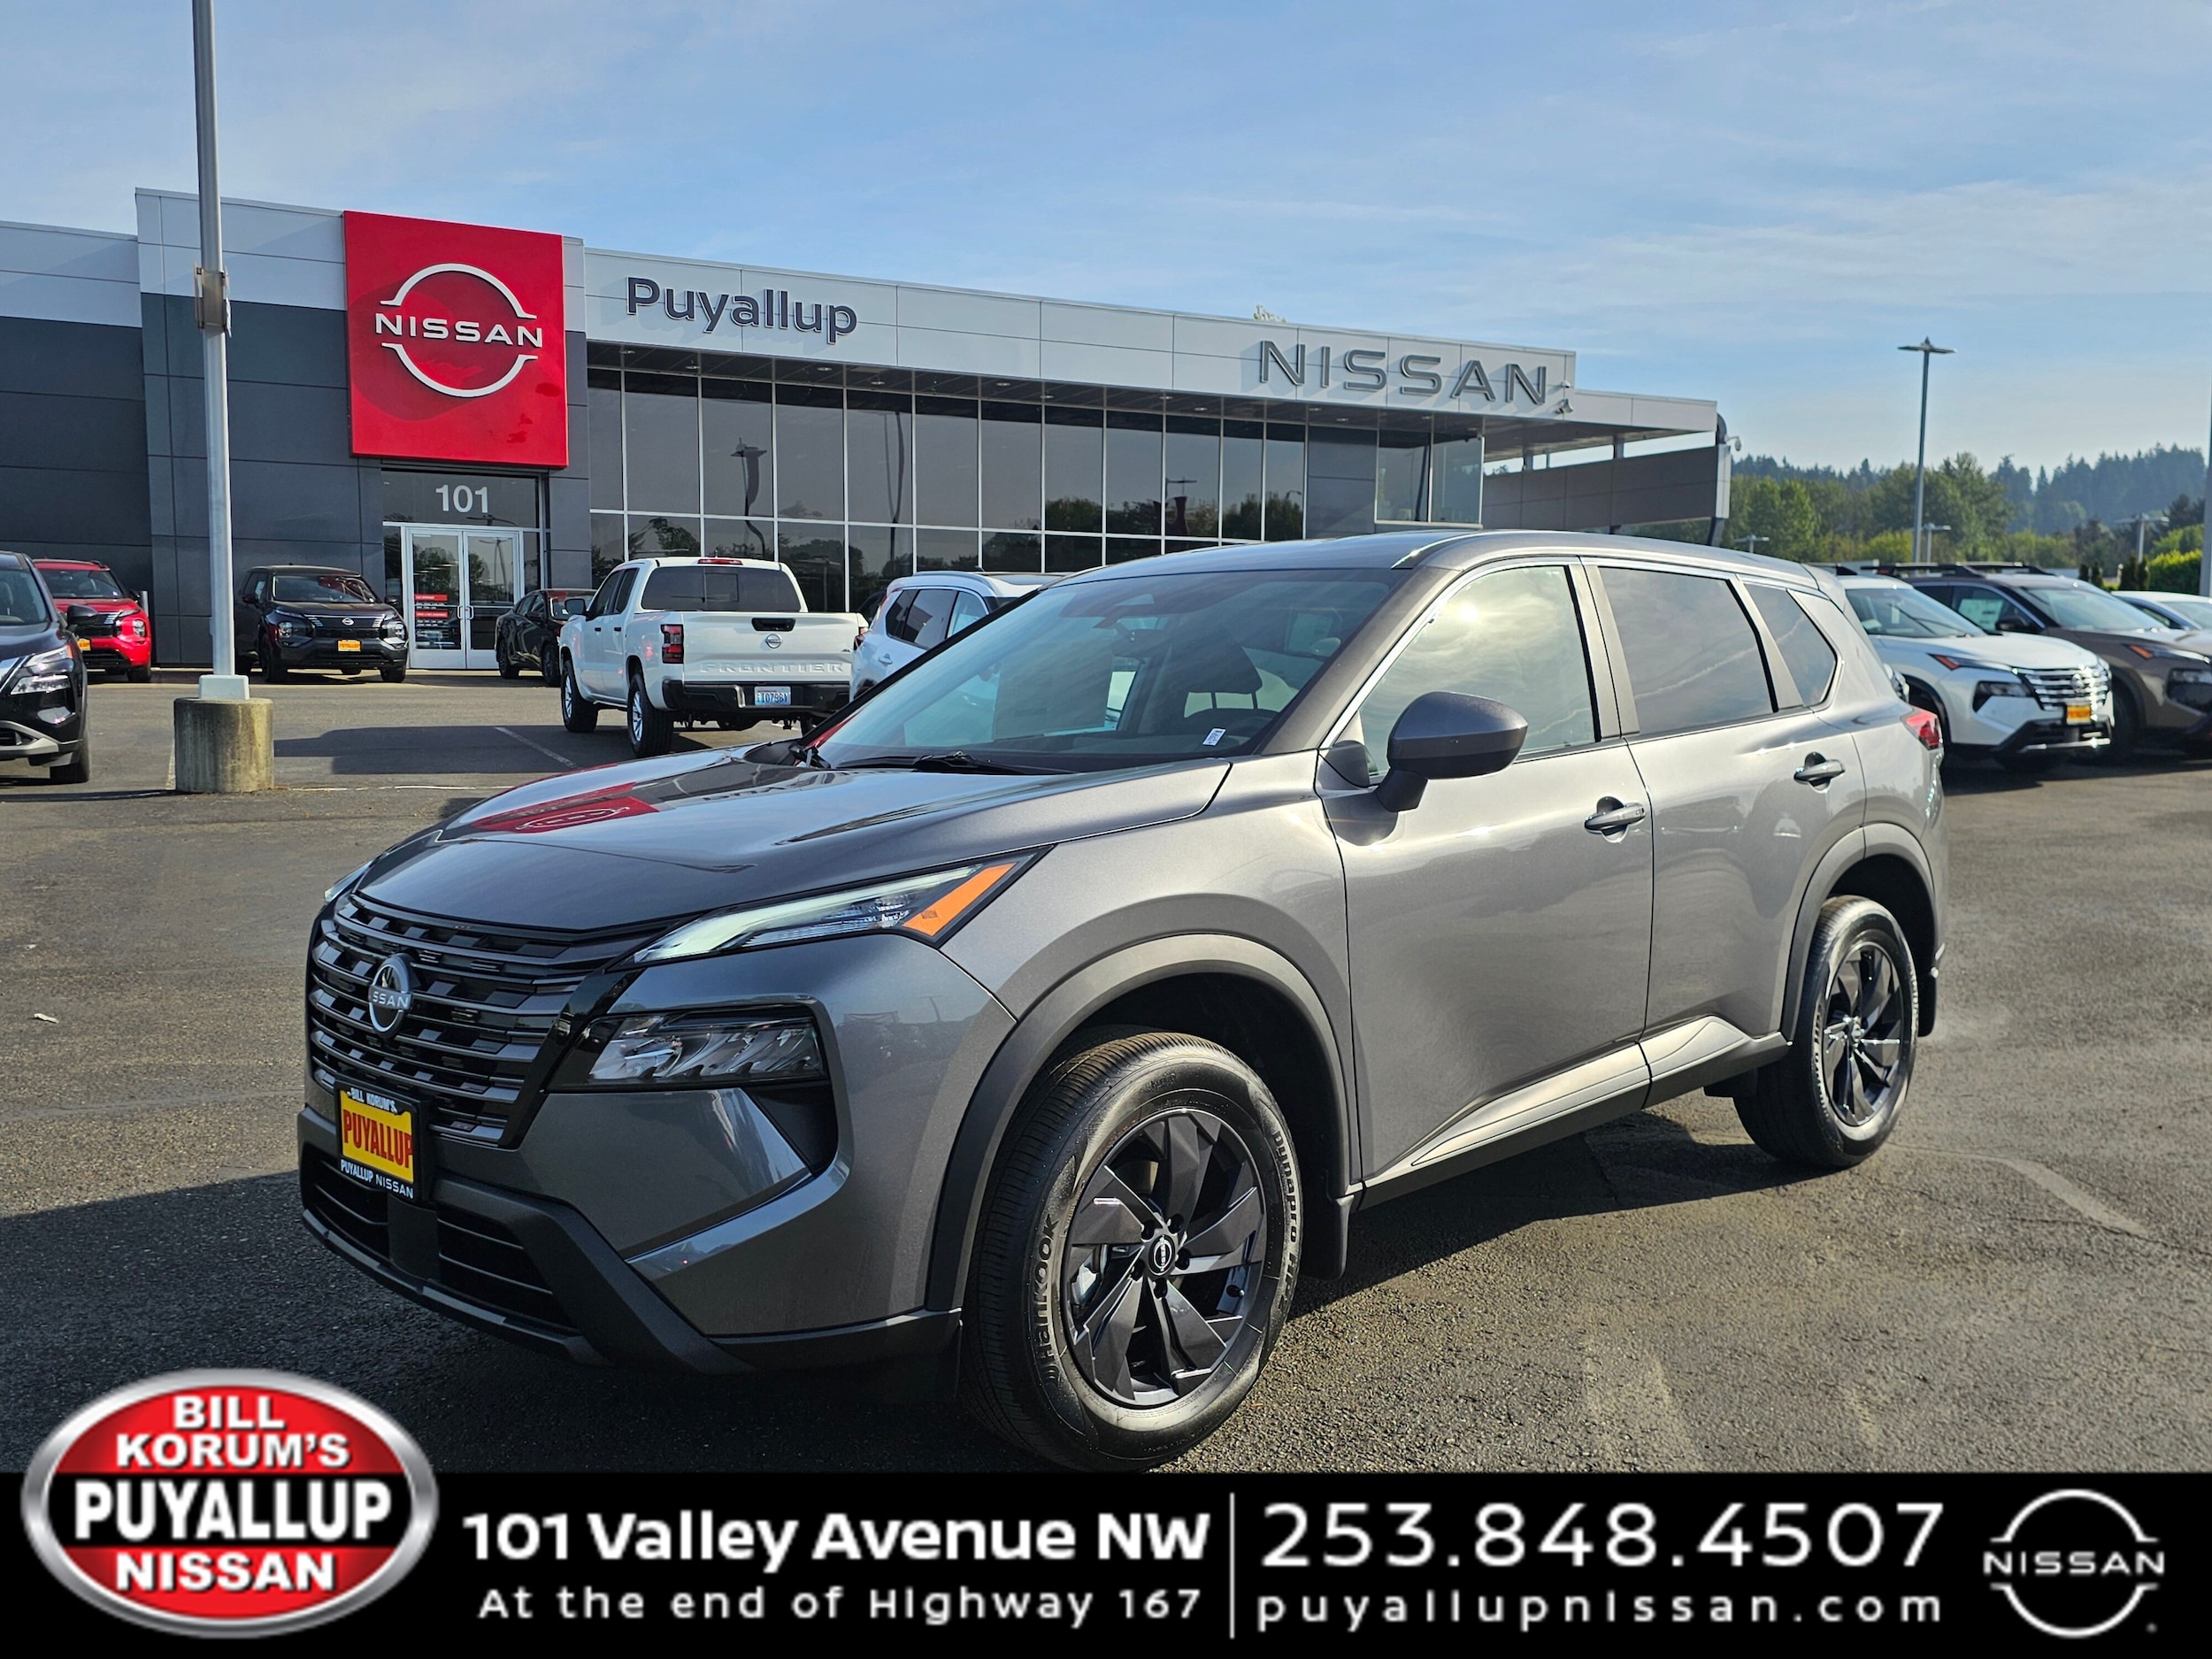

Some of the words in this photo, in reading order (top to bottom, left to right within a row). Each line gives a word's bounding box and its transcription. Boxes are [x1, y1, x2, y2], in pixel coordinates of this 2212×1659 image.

[626, 276, 857, 344] Puyallup
[375, 312, 543, 348] NISSAN
[1260, 340, 1547, 405] NISSAN
[435, 484, 488, 513] 101
[700, 663, 844, 673] FRONTIER
[350, 1087, 365, 1102] BILL
[366, 1093, 397, 1113] KORUM'S
[343, 1109, 413, 1169] PUYALLUP
[341, 1159, 373, 1183] PUYALLUP
[375, 1173, 414, 1199] NISSAN
